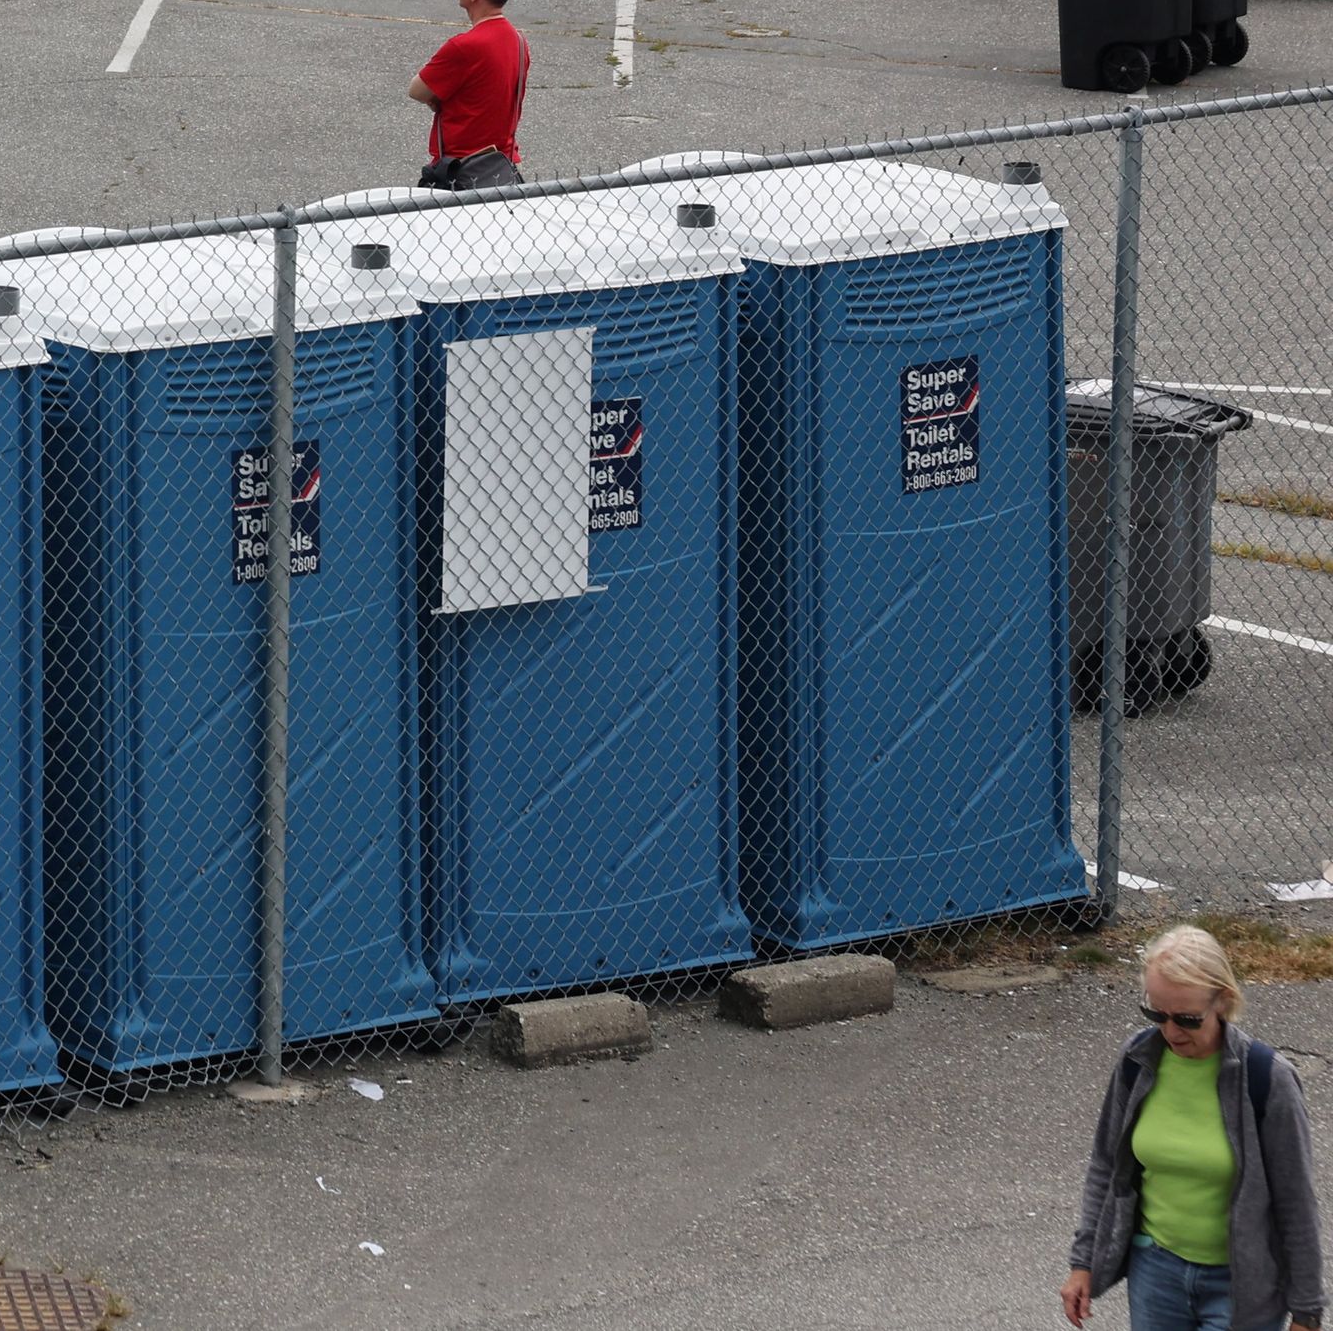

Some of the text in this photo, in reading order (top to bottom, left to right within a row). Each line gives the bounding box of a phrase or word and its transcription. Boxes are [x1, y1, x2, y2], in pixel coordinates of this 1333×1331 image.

[907, 366, 967, 391] Super
[907, 393, 956, 414] Save
[592, 408, 628, 426] per
[590, 434, 616, 450] ve
[906, 423, 955, 449] Toilet
[238, 451, 306, 478] Sur
[906, 444, 974, 470] Rentals
[590, 465, 615, 485] let
[904, 466, 978, 491] 1-800-665-2800
[238, 477, 269, 499] Sa
[589, 488, 634, 508] ntals
[237, 512, 269, 536] Toil
[589, 509, 639, 531] -665-2800
[237, 532, 313, 560] Reals
[235, 554, 317, 581] 1-800--2800
